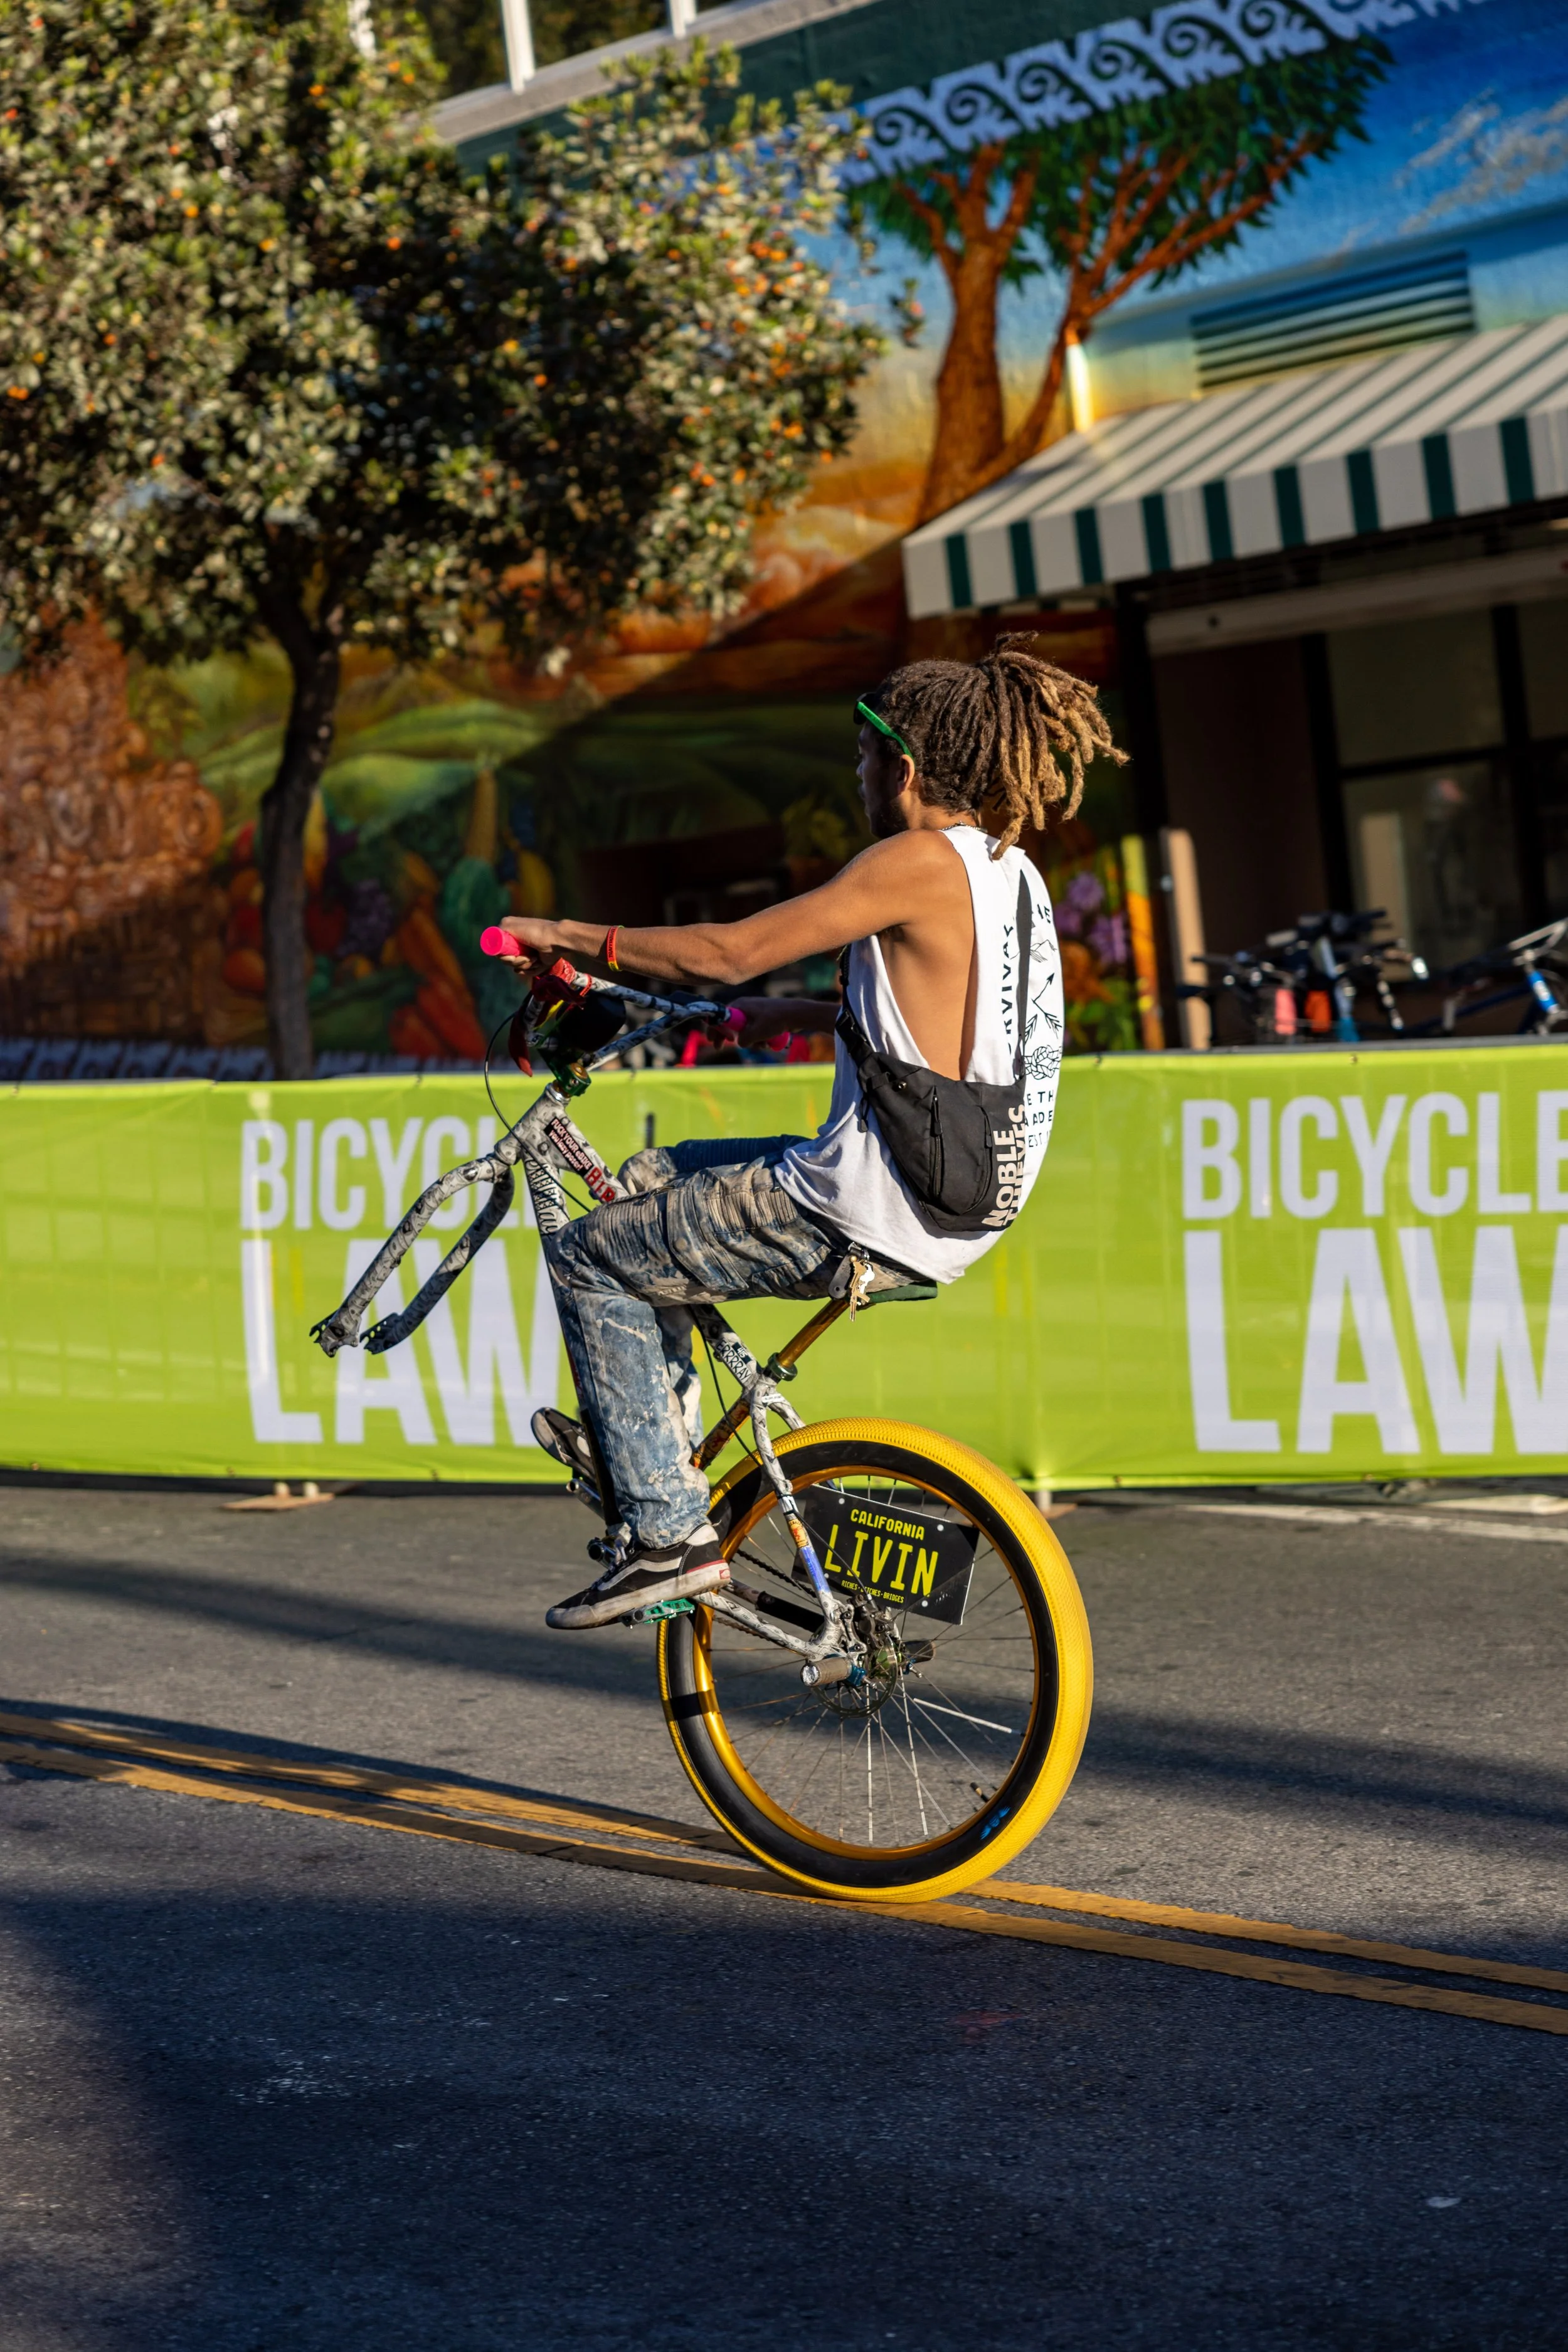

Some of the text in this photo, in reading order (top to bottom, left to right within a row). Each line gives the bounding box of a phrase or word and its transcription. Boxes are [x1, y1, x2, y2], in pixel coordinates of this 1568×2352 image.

[551, 1119, 567, 1136] FUCK
[562, 1133, 580, 1153] YOUR
[1182, 1091, 1568, 1219] BICYCLE
[982, 1130, 1016, 1227] NOBLE
[241, 1239, 559, 1447] LAW
[1184, 1224, 1568, 1454] LAW
[824, 1525, 940, 1597] LIVIN
[850, 1508, 926, 1540] CALIFORNIA
[841, 1580, 859, 1590] RICHES
[883, 1592, 905, 1604] BRIDGES
